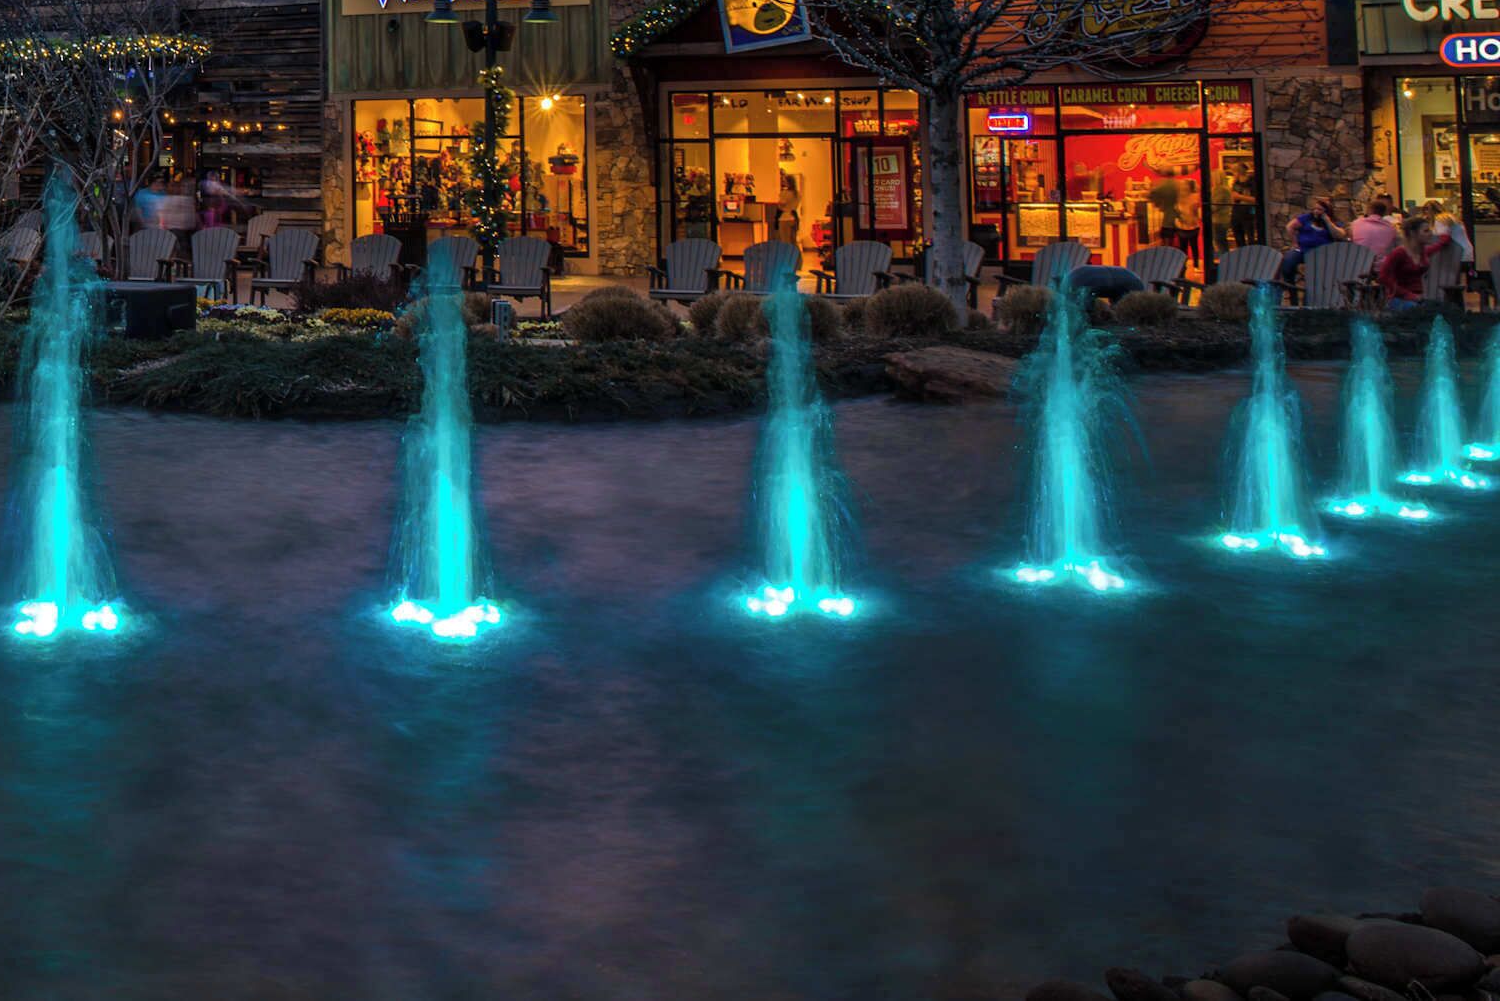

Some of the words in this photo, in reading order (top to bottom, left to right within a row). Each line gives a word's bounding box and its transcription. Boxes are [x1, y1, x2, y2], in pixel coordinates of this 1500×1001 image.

[978, 90, 1018, 105] KETTLE
[1020, 90, 1050, 105] CORN
[1063, 86, 1114, 103] CARAMEL
[1116, 86, 1148, 102] CORN
[1155, 85, 1198, 102] CHEESE
[1208, 85, 1239, 101] CORN
